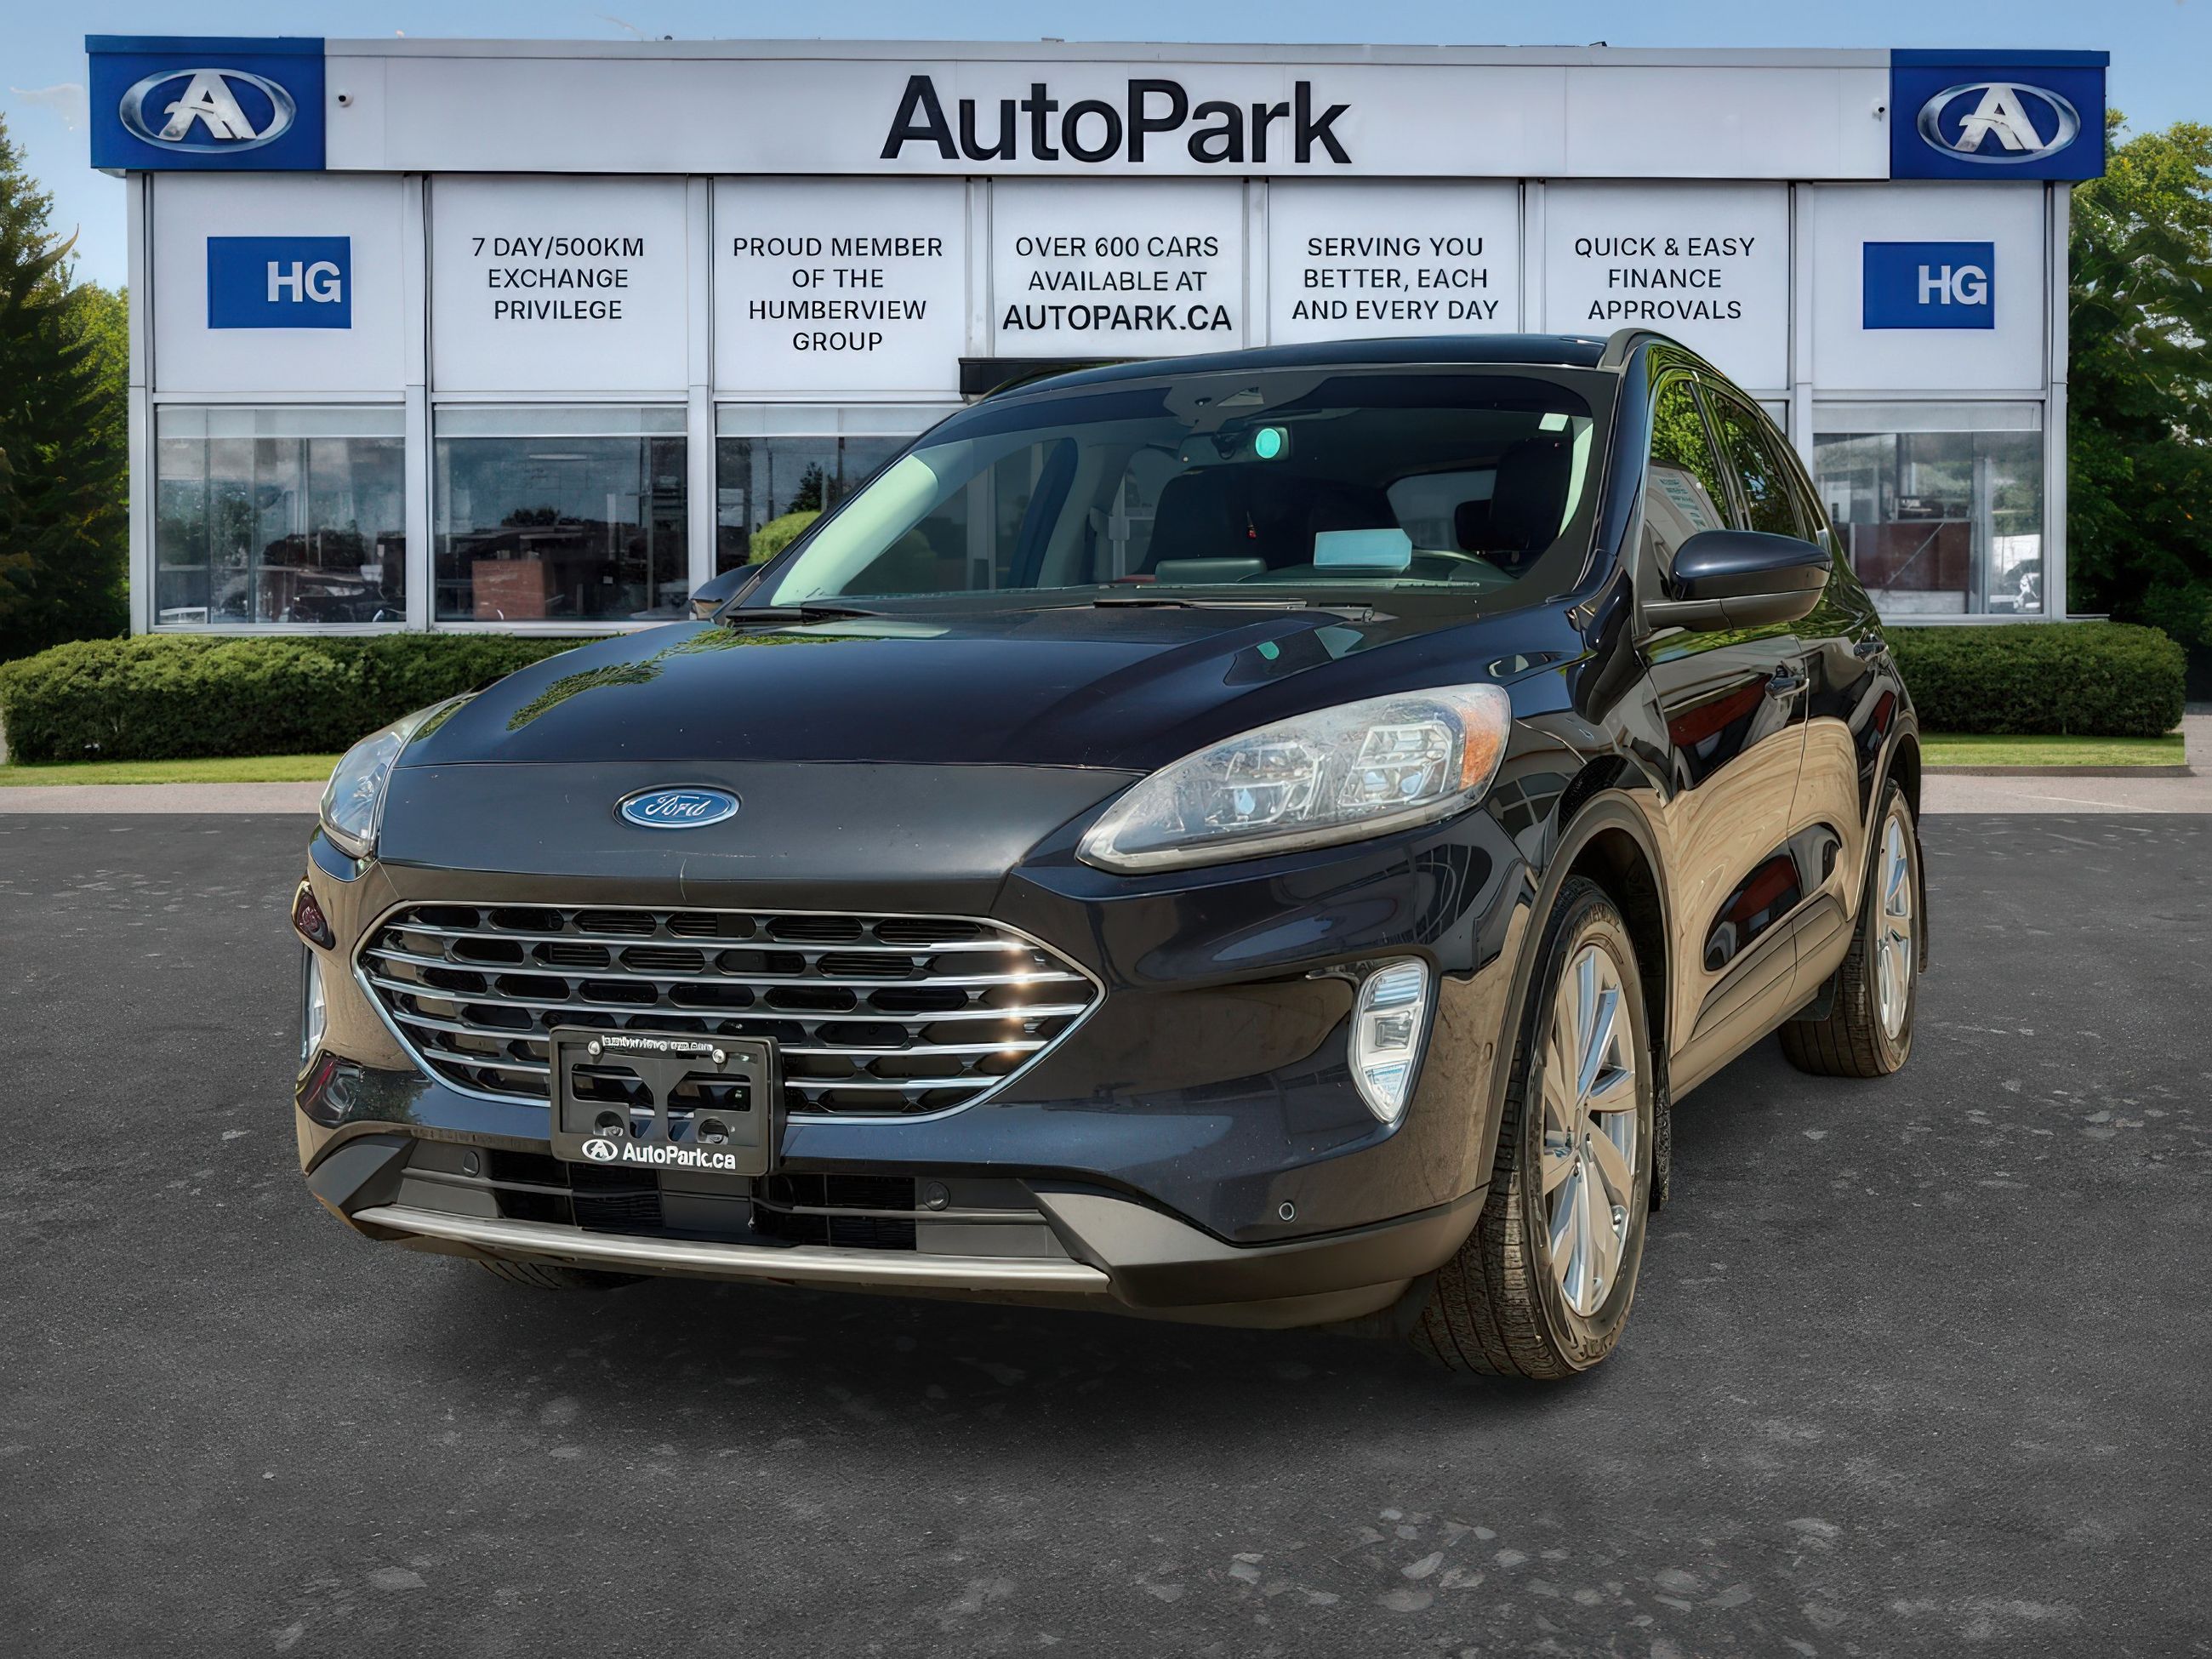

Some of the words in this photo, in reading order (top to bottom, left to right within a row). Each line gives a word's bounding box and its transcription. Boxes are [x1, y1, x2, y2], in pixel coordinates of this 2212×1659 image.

[880, 75, 1352, 163] AutoPark
[473, 238, 485, 256] 7
[495, 237, 644, 259] DAY/500KM
[733, 237, 822, 257] PROUD
[831, 237, 943, 257] MEMBER
[1016, 237, 1086, 257] OVER
[1095, 237, 1139, 258] 600
[1147, 237, 1218, 258] CARS
[1308, 237, 1421, 257] SERVING
[1429, 237, 1483, 257] YOU
[1575, 237, 1656, 258] QUICK
[1665, 237, 1679, 256] &
[1688, 237, 1755, 257] EASY
[267, 261, 341, 303] HG
[488, 268, 629, 288] EXCHANGE
[792, 269, 824, 288] OF
[833, 269, 884, 288] THE
[1028, 271, 1168, 292] AVAILABLE
[1176, 271, 1207, 292] AT
[1304, 268, 1409, 292] BETTER,
[1417, 268, 1487, 288] EACH
[1609, 268, 1721, 288] FINANCE
[1918, 265, 1987, 305] HG
[494, 299, 622, 320] PRIVILEGE
[750, 299, 926, 320] HUMBERVIEW
[1002, 304, 1233, 331] AUTOPARK.CA
[1291, 299, 1348, 320] AND
[1356, 299, 1440, 320] EVERY
[1448, 299, 1499, 320] DAY
[1588, 299, 1742, 320] APPROVALS
[792, 331, 883, 351] GROUP
[645, 795, 711, 817] Ford
[622, 1142, 737, 1170] AutoPark.ca
